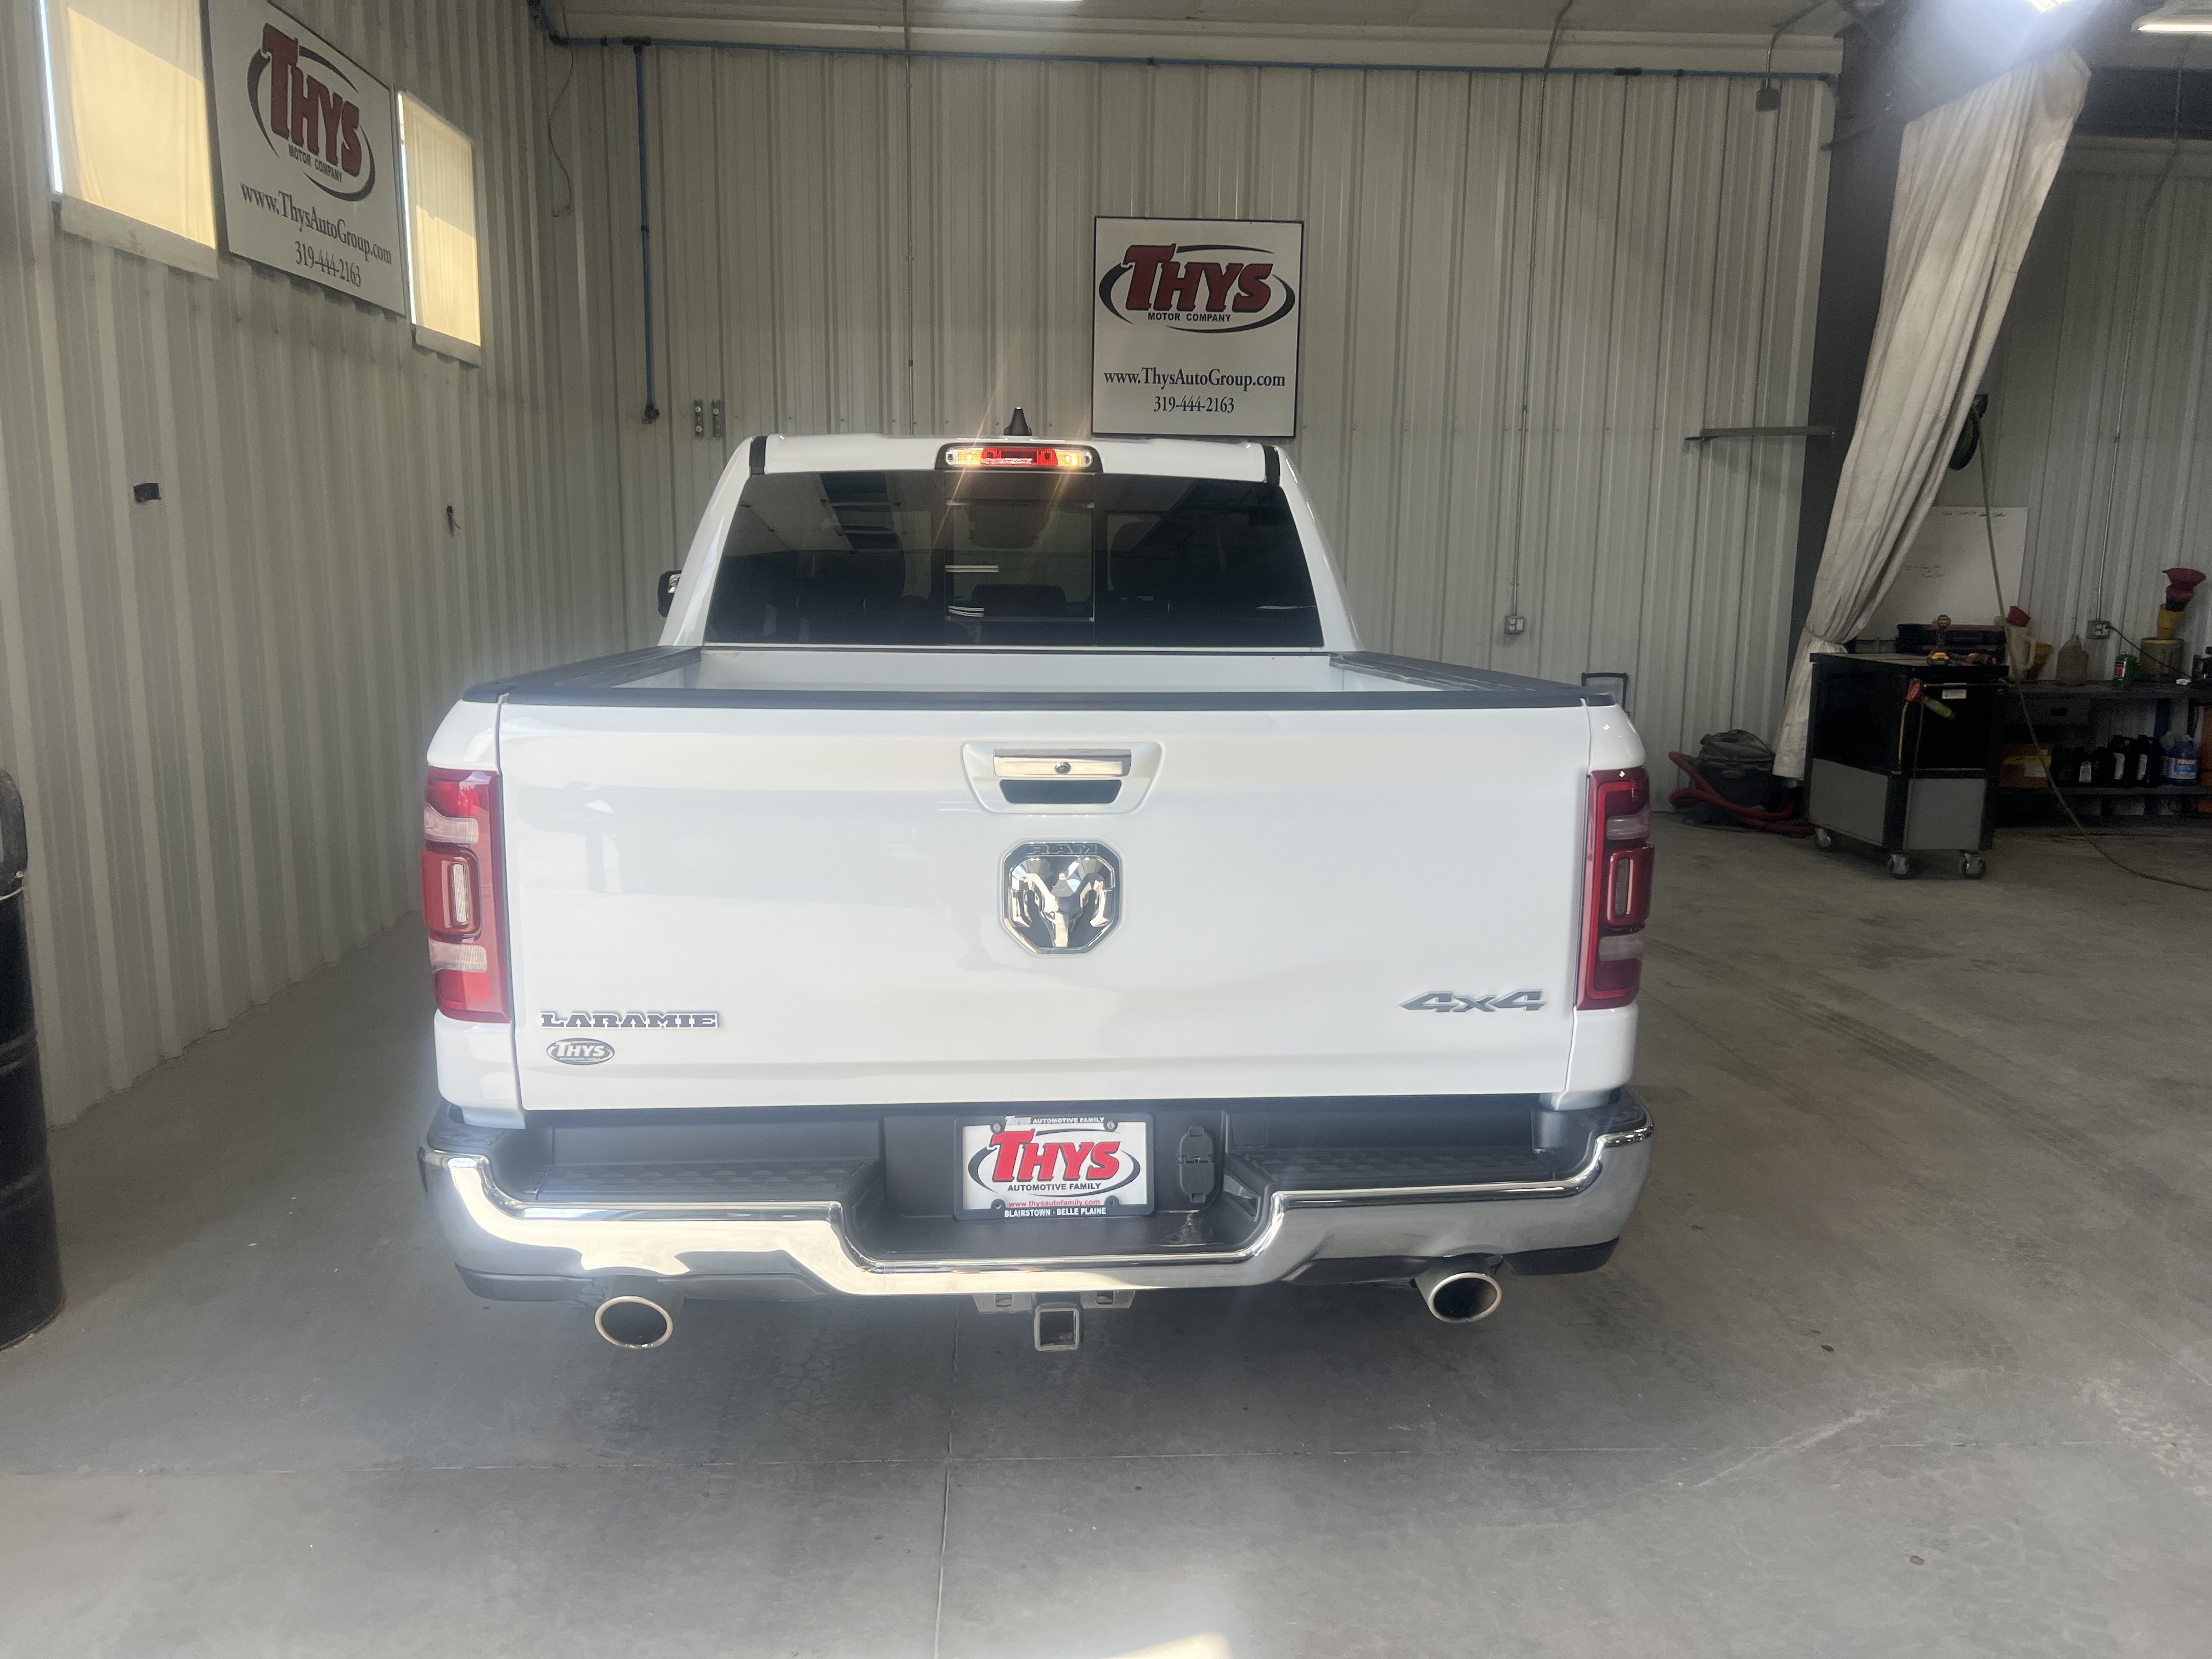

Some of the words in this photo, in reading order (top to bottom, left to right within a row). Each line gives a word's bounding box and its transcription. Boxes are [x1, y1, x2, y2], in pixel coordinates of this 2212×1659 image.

[262, 22, 362, 177] THYS
[288, 148, 312, 165] MOTOR
[314, 158, 343, 183] COMPANY
[239, 183, 392, 264] www.ThysAutoGroup.com
[295, 240, 362, 287] 319-444-2163
[1122, 243, 1273, 312] THYS
[1148, 312, 1181, 321] MOTOR
[1186, 313, 1231, 322] COMPANY
[1103, 367, 1286, 392] www.ThysAutoGroup.com
[1154, 395, 1234, 414] 319-444-2163
[1027, 844, 1098, 855] RAM
[540, 1012, 719, 1029] LARAMIE
[555, 1041, 605, 1057] THYS
[1005, 1115, 1031, 1125] THYS
[989, 1128, 1121, 1182] THYS
[1007, 1183, 1066, 1192] AUTOMOTIVE
[1004, 1209, 1051, 1217] BLAIRSTOWN
